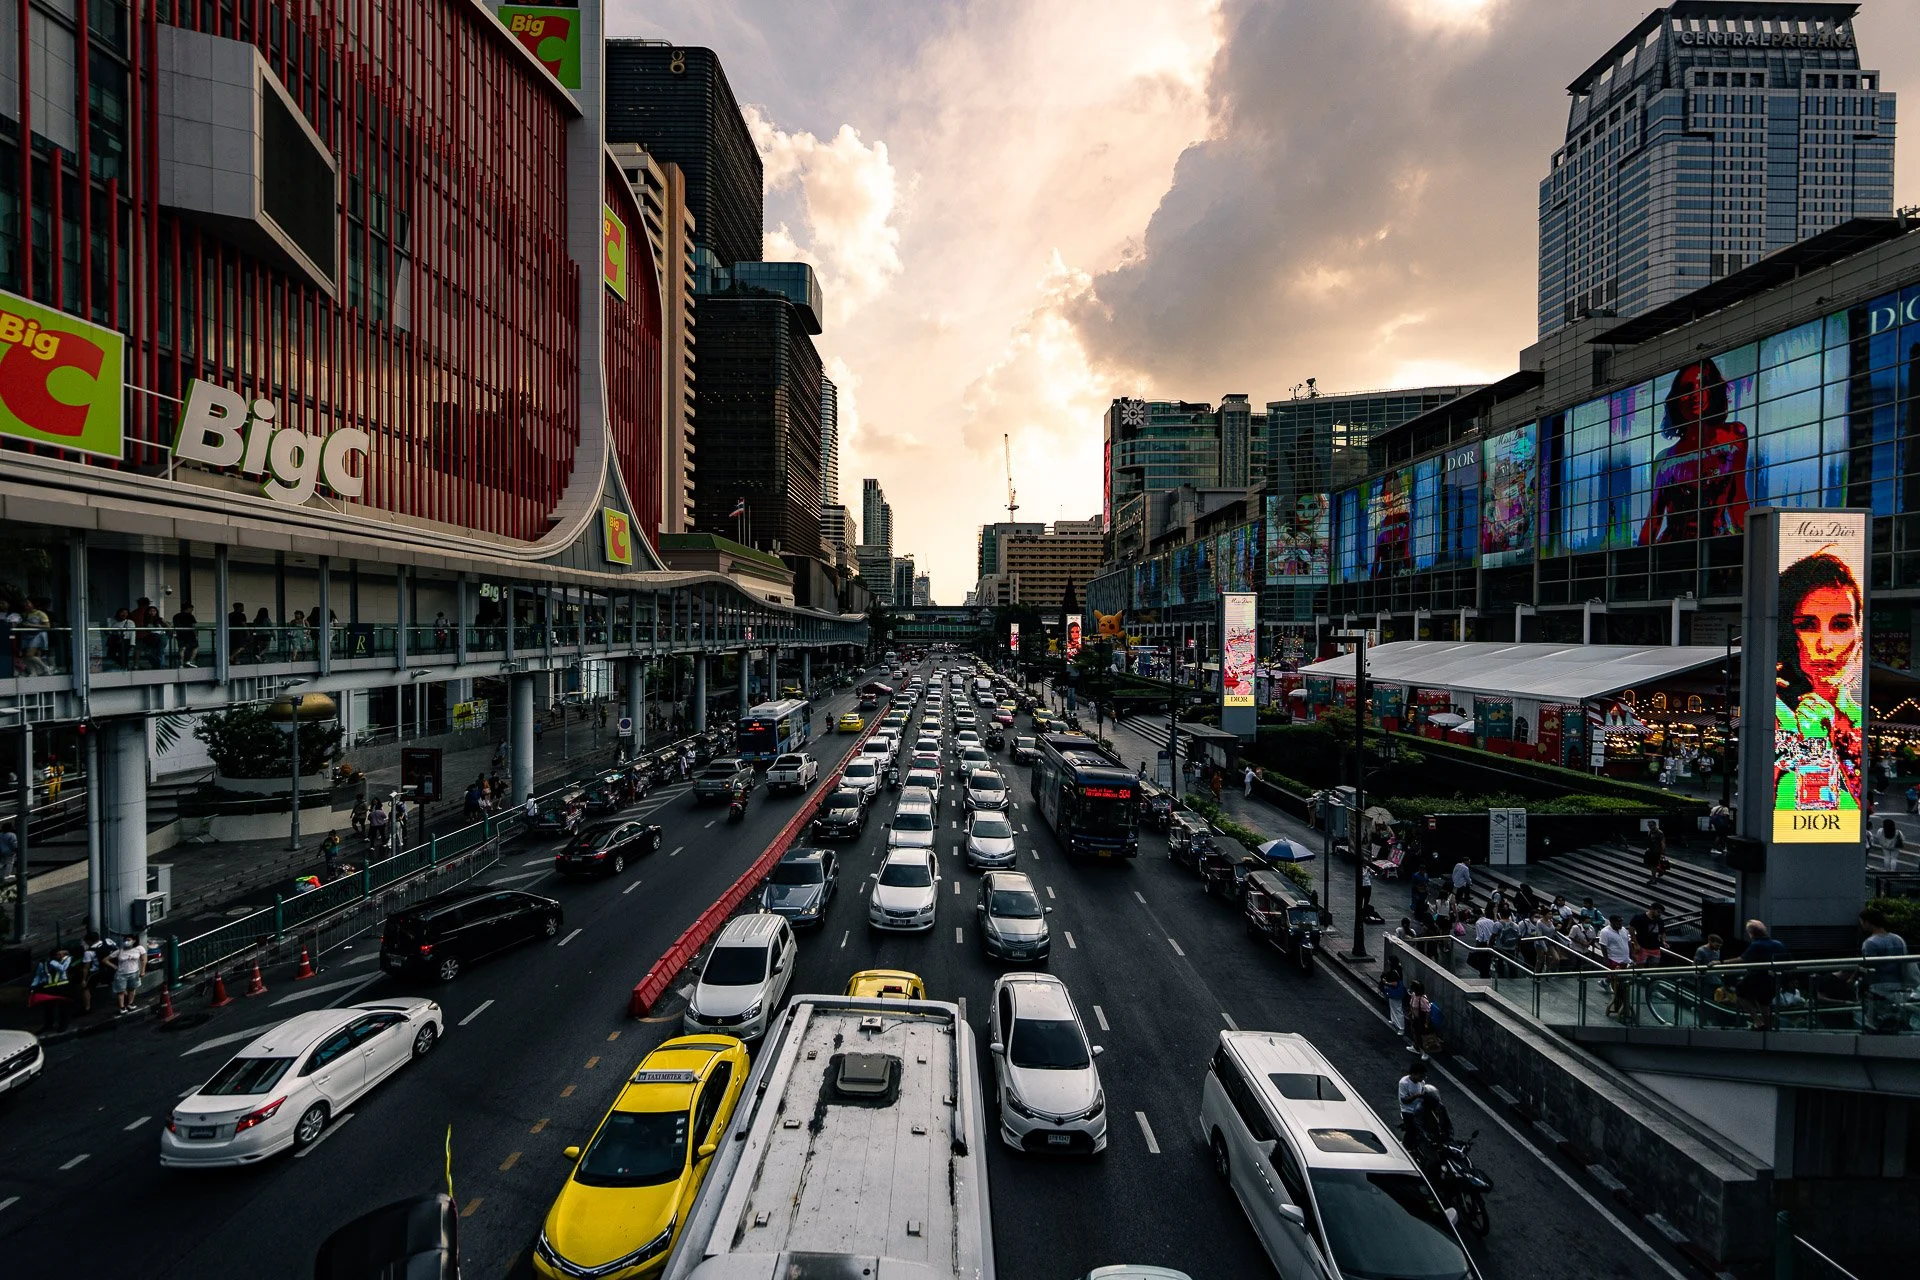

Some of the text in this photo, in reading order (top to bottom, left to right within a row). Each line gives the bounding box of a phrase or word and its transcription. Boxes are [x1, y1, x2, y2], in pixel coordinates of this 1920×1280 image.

[510, 13, 546, 37] Big
[0, 312, 60, 361] Big
[0, 331, 105, 437] C
[1447, 450, 1475, 472] DOR
[609, 515, 620, 532] Big
[1787, 521, 1856, 537] Miss Dior
[612, 518, 626, 559] C
[480, 582, 500, 603] Big
[1230, 694, 1248, 703] DIOR
[1118, 789, 1131, 799] 504
[1793, 814, 1841, 830] DIOR
